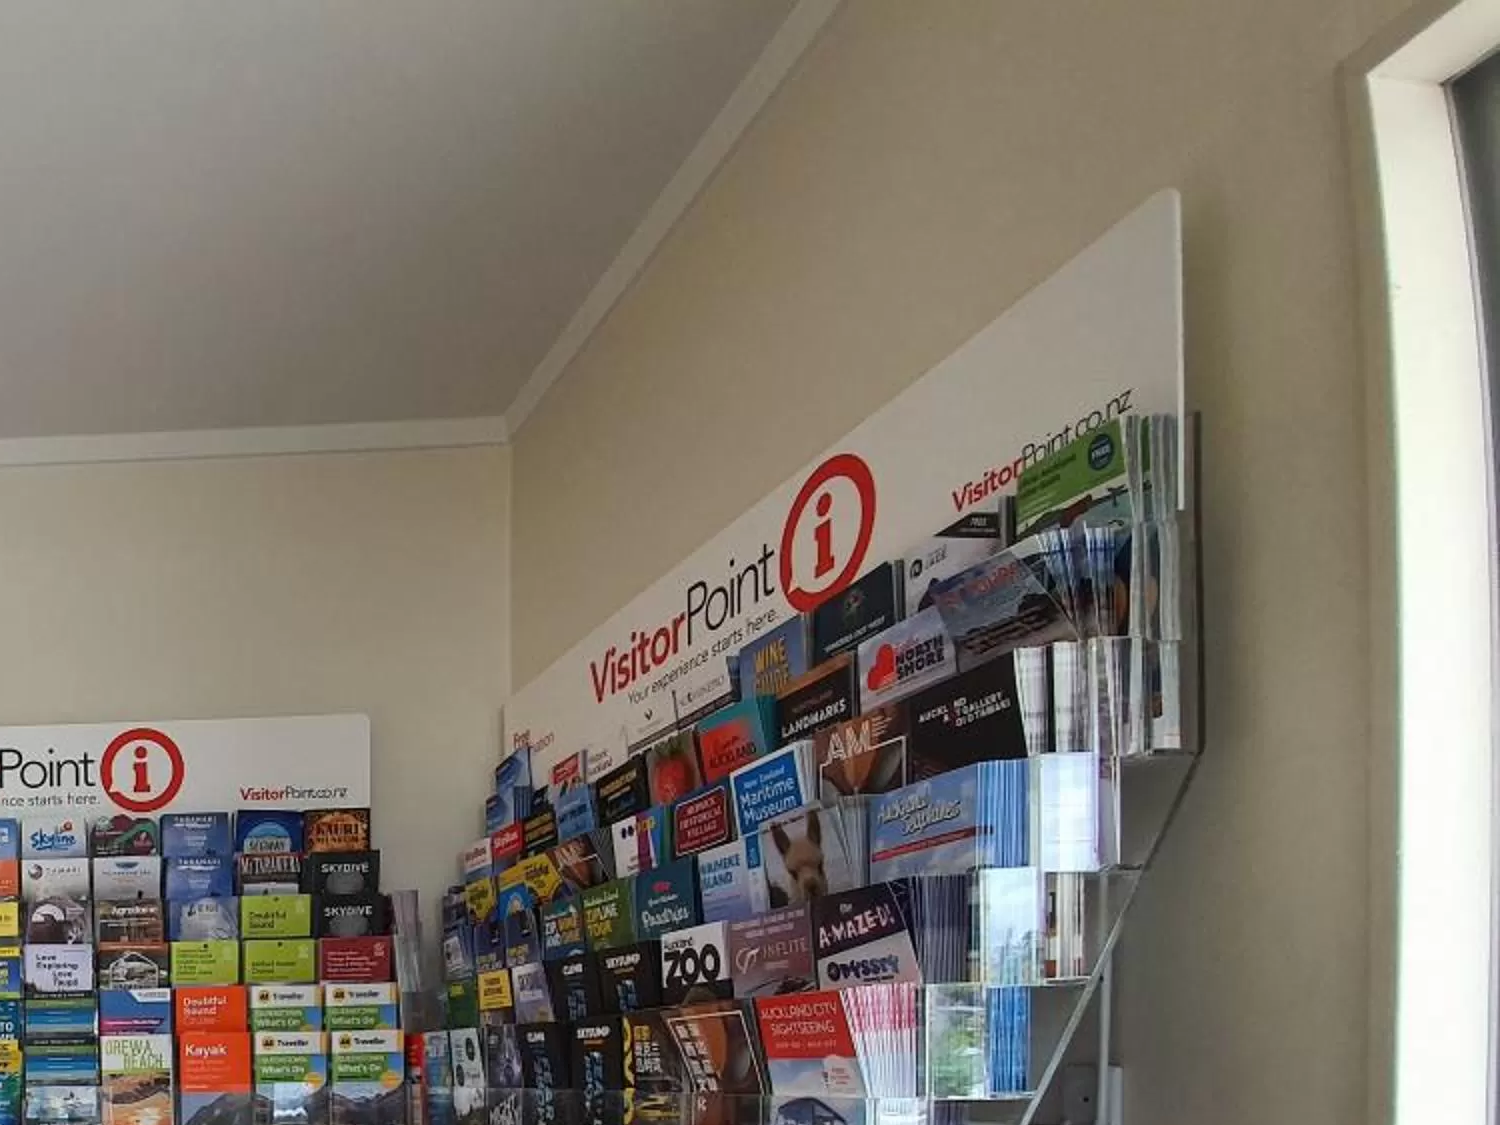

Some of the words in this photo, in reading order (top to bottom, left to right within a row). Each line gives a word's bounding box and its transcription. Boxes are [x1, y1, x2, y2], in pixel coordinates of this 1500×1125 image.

[952, 389, 1133, 513] VisitorPoint.co.nz
[590, 544, 775, 704] VisitorPoint
[754, 638, 788, 671] WINE
[896, 634, 943, 664] NORTH
[627, 687, 651, 706] Your
[652, 654, 708, 693] experience
[711, 628, 743, 658] starts
[898, 653, 945, 684] SHORE
[781, 699, 846, 738] LANDMARKS
[28, 795, 63, 808] starts
[67, 792, 100, 806] here.
[740, 778, 795, 808] Maritime
[743, 795, 797, 826] Museum
[316, 822, 359, 836] KAURI
[30, 830, 77, 852] Skyline
[321, 863, 370, 874] SKYDIVE
[324, 905, 373, 917] SKYDIVE
[664, 943, 720, 988] ZOO
[183, 996, 227, 1007] Doubtful
[184, 1006, 217, 1017] Sound
[0, 1023, 15, 1035] TO
[771, 1021, 836, 1037] SIGHTSEEING
[104, 1038, 155, 1057] OREWA
[185, 1043, 228, 1061] Kayak
[123, 1052, 165, 1071] BEACH
